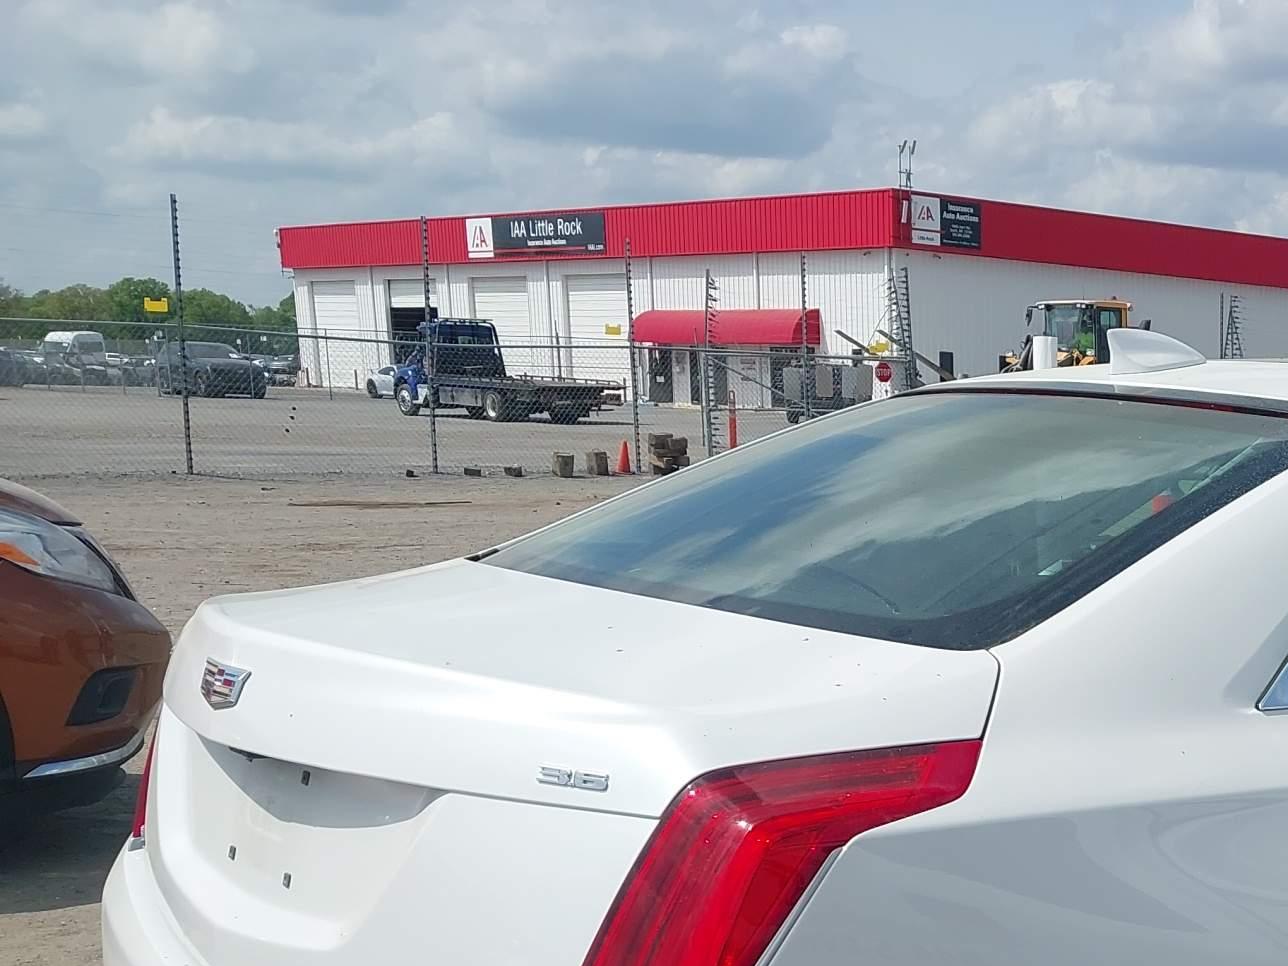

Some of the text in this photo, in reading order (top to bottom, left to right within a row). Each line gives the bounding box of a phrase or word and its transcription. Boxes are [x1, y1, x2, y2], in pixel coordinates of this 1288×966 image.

[942, 210, 956, 220] Auto
[510, 217, 582, 238] IAA Little Rock
[876, 368, 890, 377] STOP
